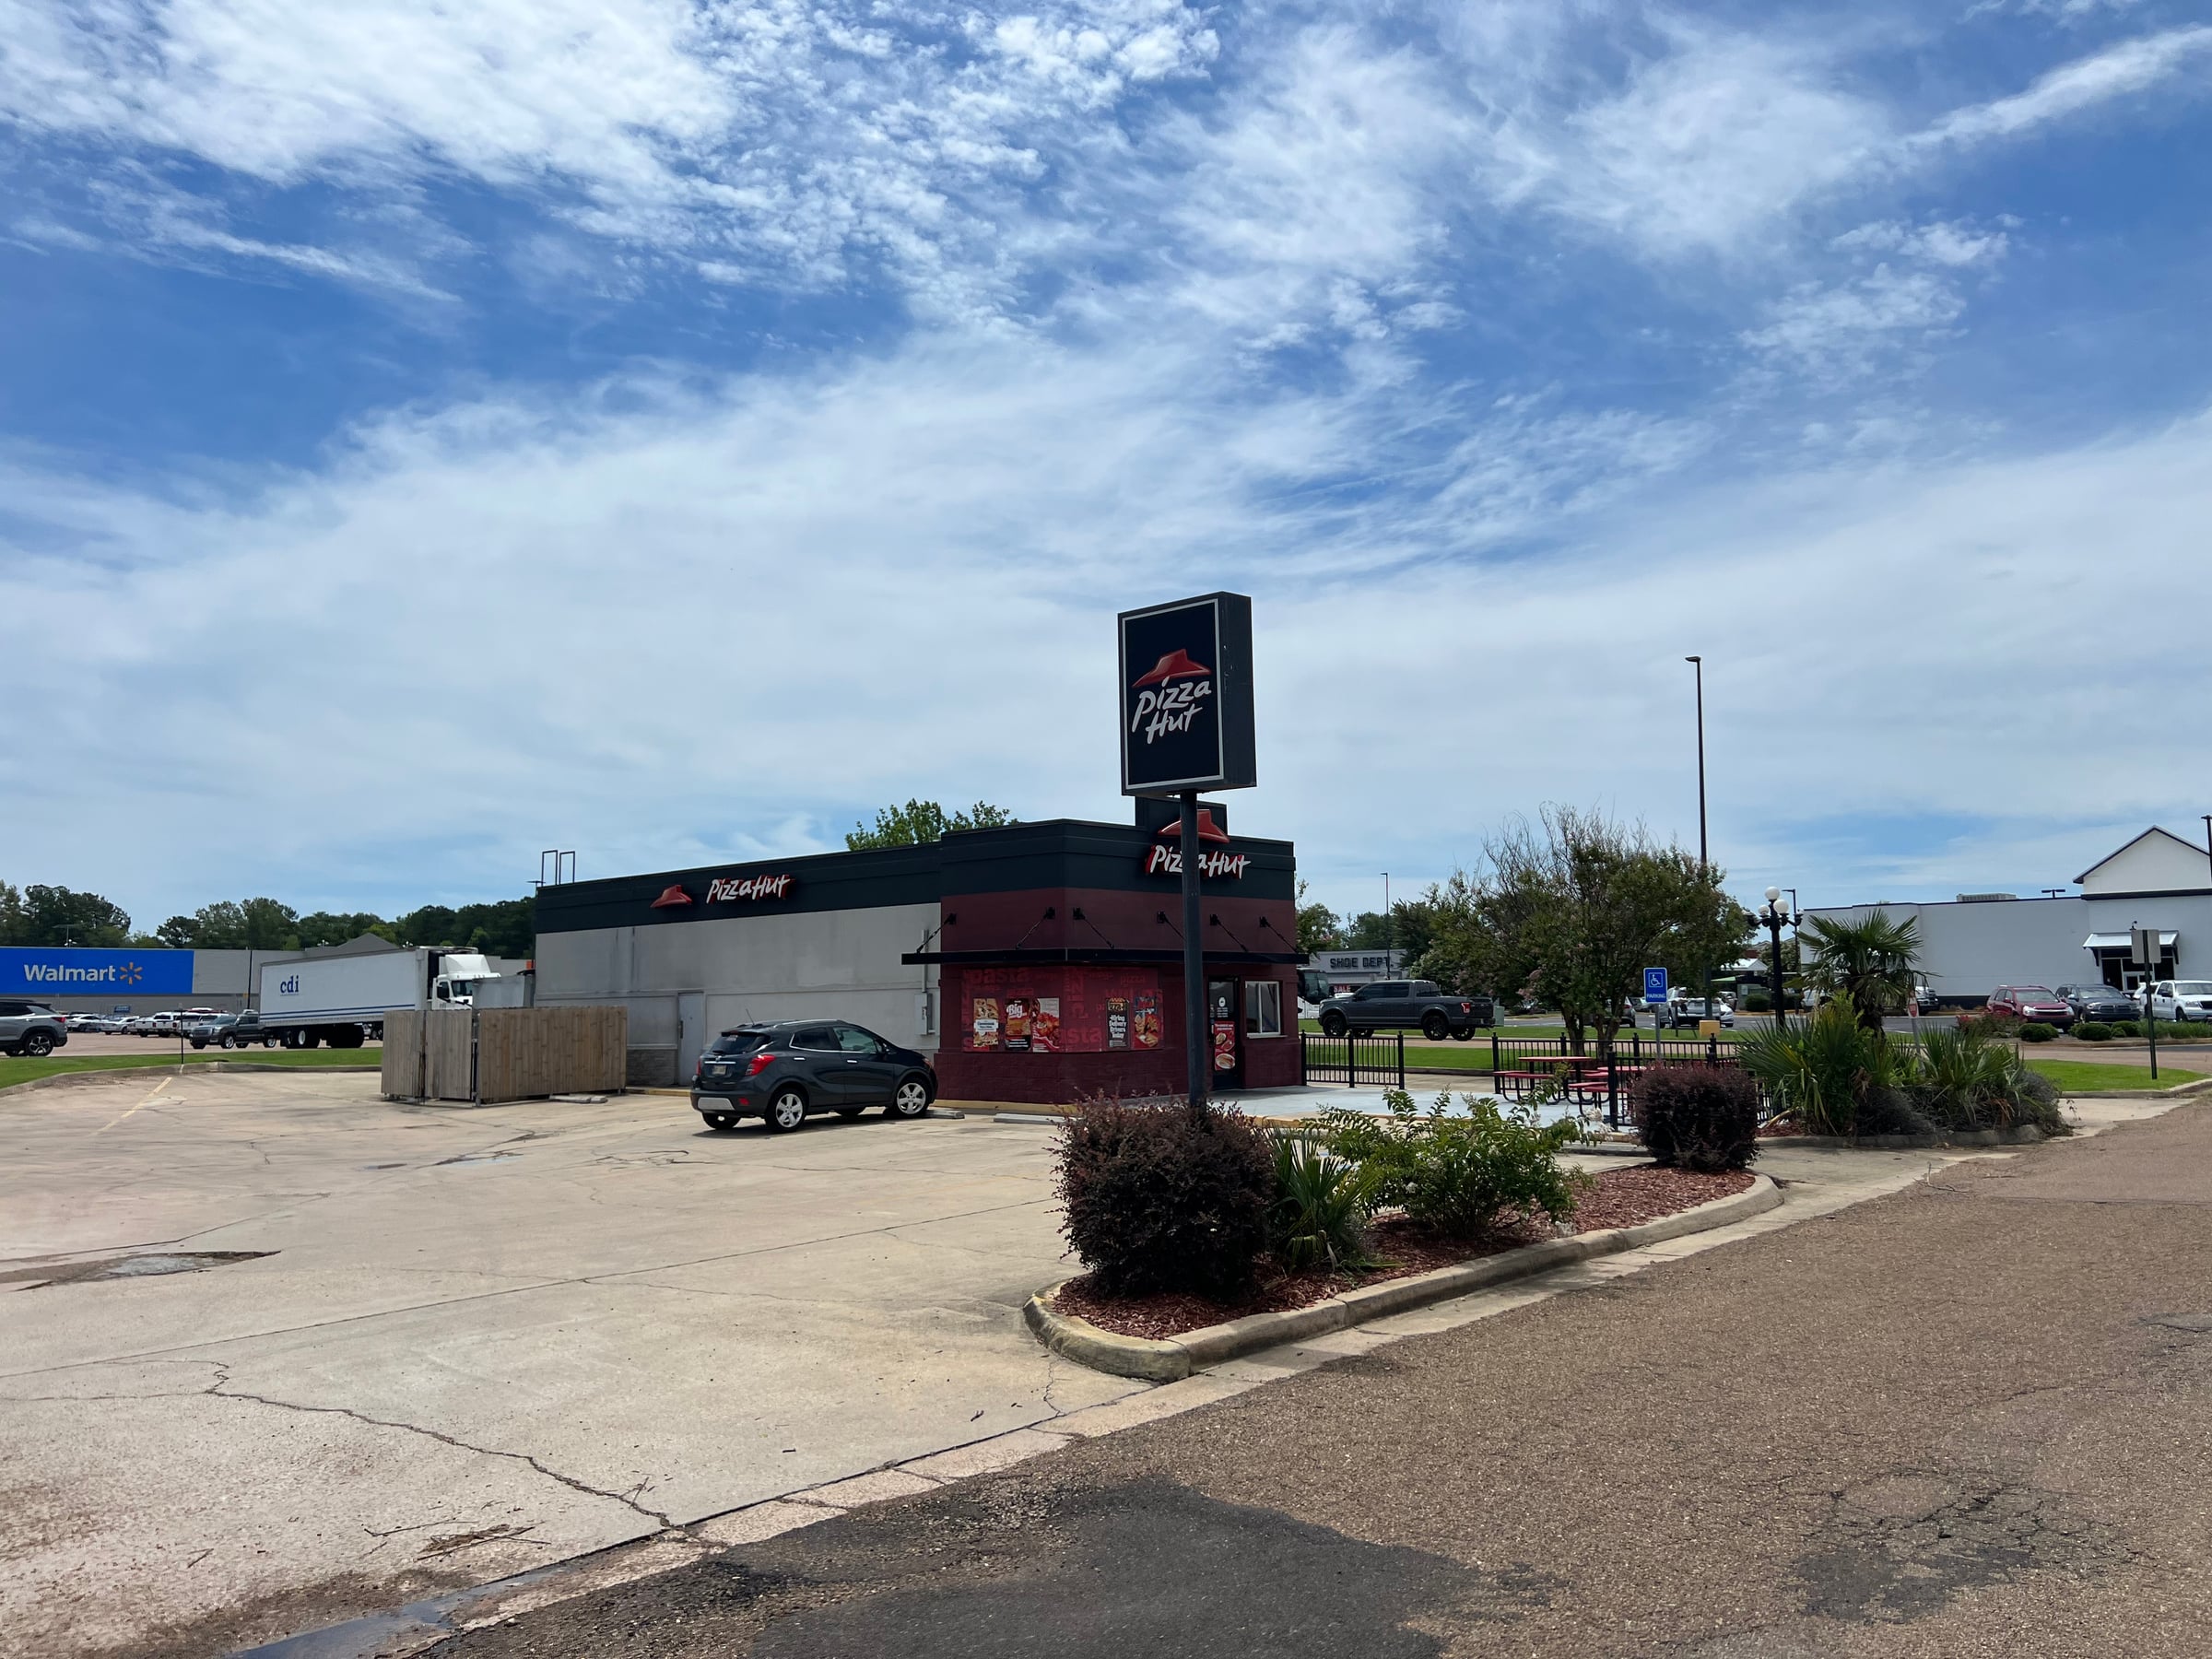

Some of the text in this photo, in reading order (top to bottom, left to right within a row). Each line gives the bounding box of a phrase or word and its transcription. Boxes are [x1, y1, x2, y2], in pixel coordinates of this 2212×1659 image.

[1132, 676, 1212, 733] Pizza
[1146, 702, 1203, 745] Hut
[1150, 844, 1251, 880] Piza Hut
[706, 874, 791, 904] Pizza Hut
[1330, 957, 1394, 968] SHOE DEPT.
[24, 964, 115, 982] Walmart
[280, 974, 299, 994] cdi
[1334, 984, 1351, 993] SALE
[1006, 1004, 1023, 1018] Big
